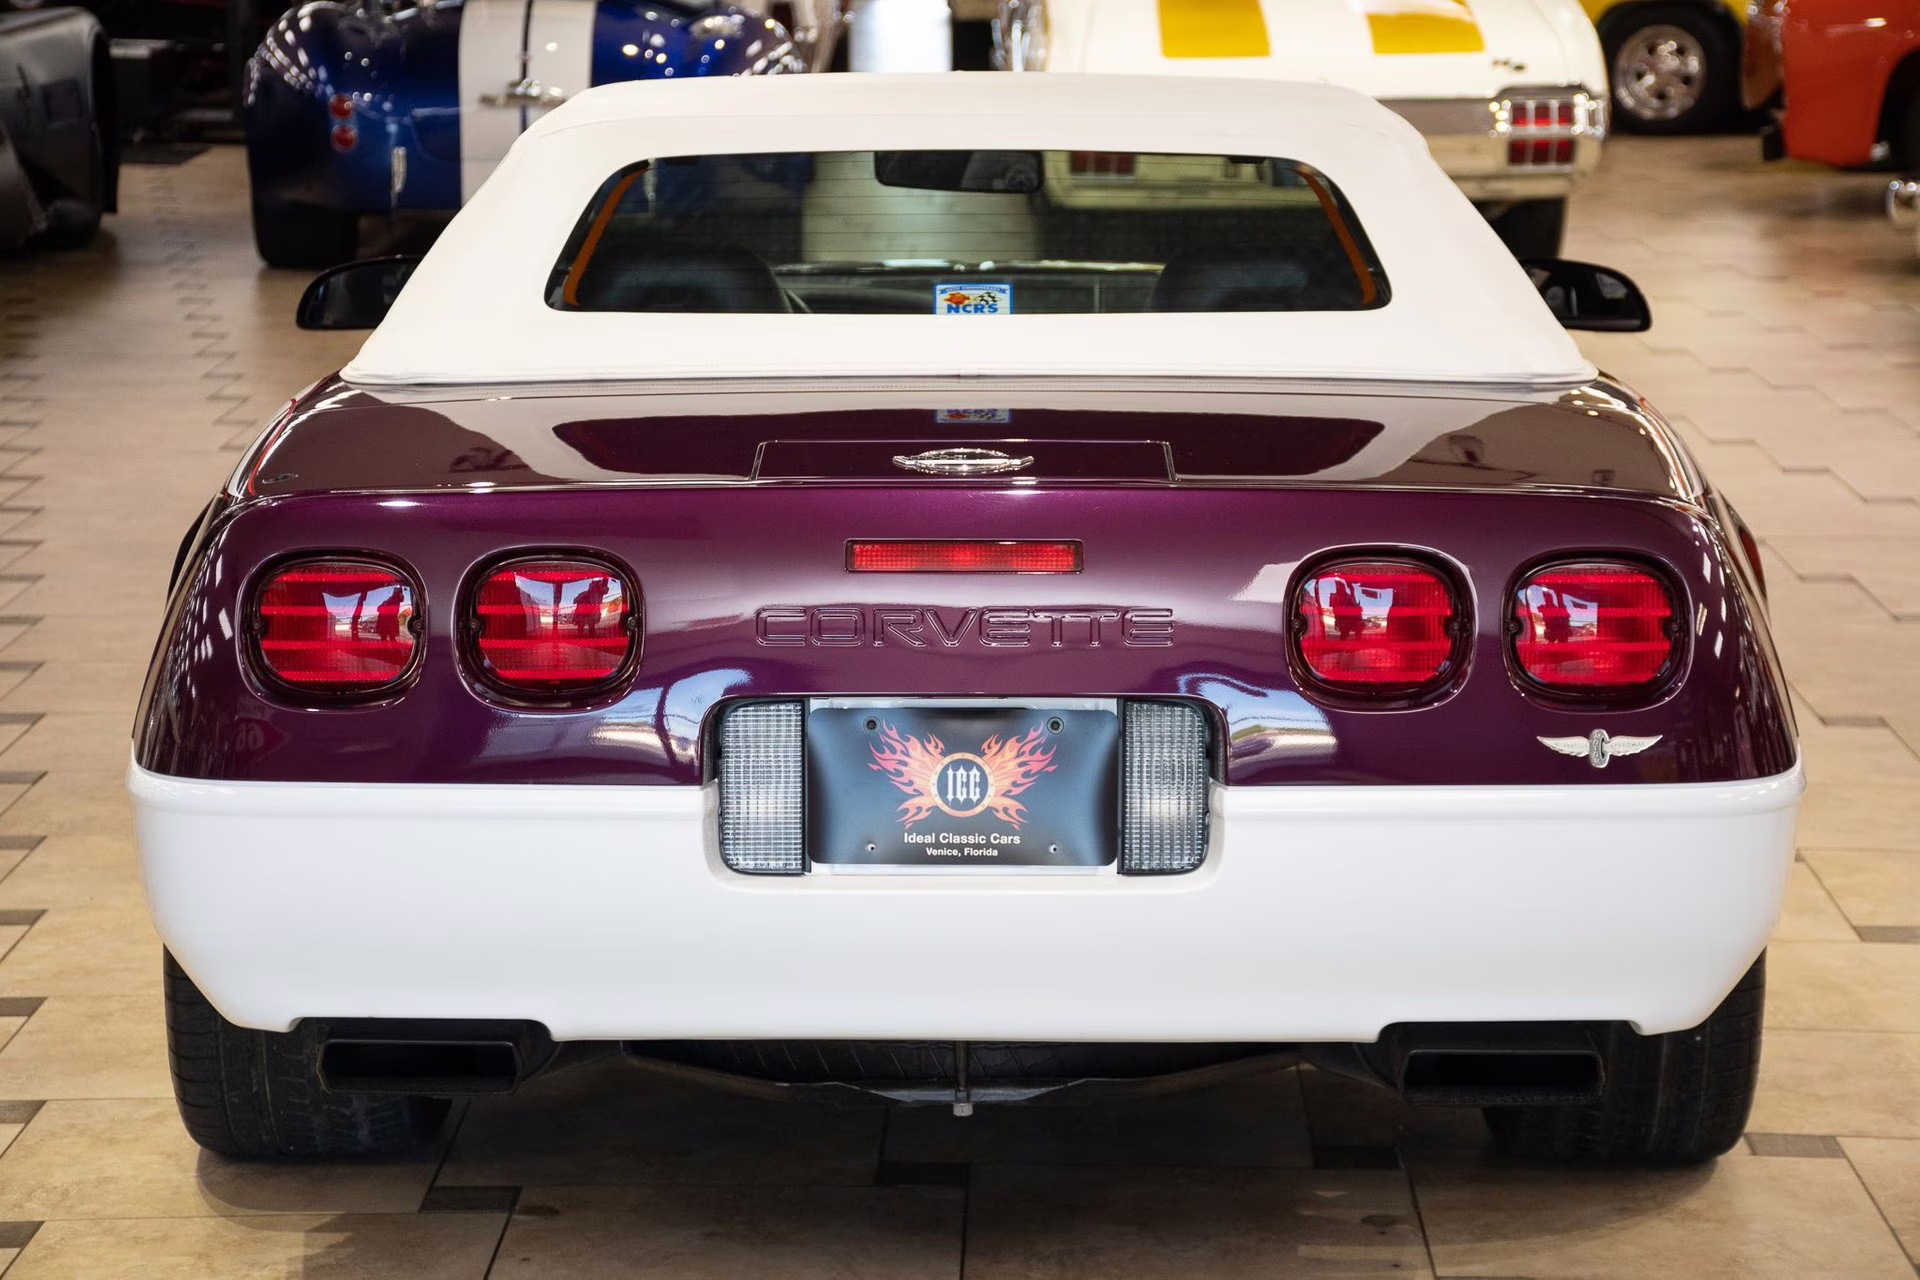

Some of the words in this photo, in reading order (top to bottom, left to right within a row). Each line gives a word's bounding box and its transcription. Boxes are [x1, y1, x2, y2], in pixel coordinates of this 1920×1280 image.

[947, 303, 998, 314] NCRS
[755, 606, 1175, 648] CORVETTE
[903, 832, 936, 843] Ideal
[939, 832, 987, 844] Classic
[990, 833, 1021, 844] Cars
[925, 847, 961, 857] Venice,
[964, 847, 998, 856] Florida
